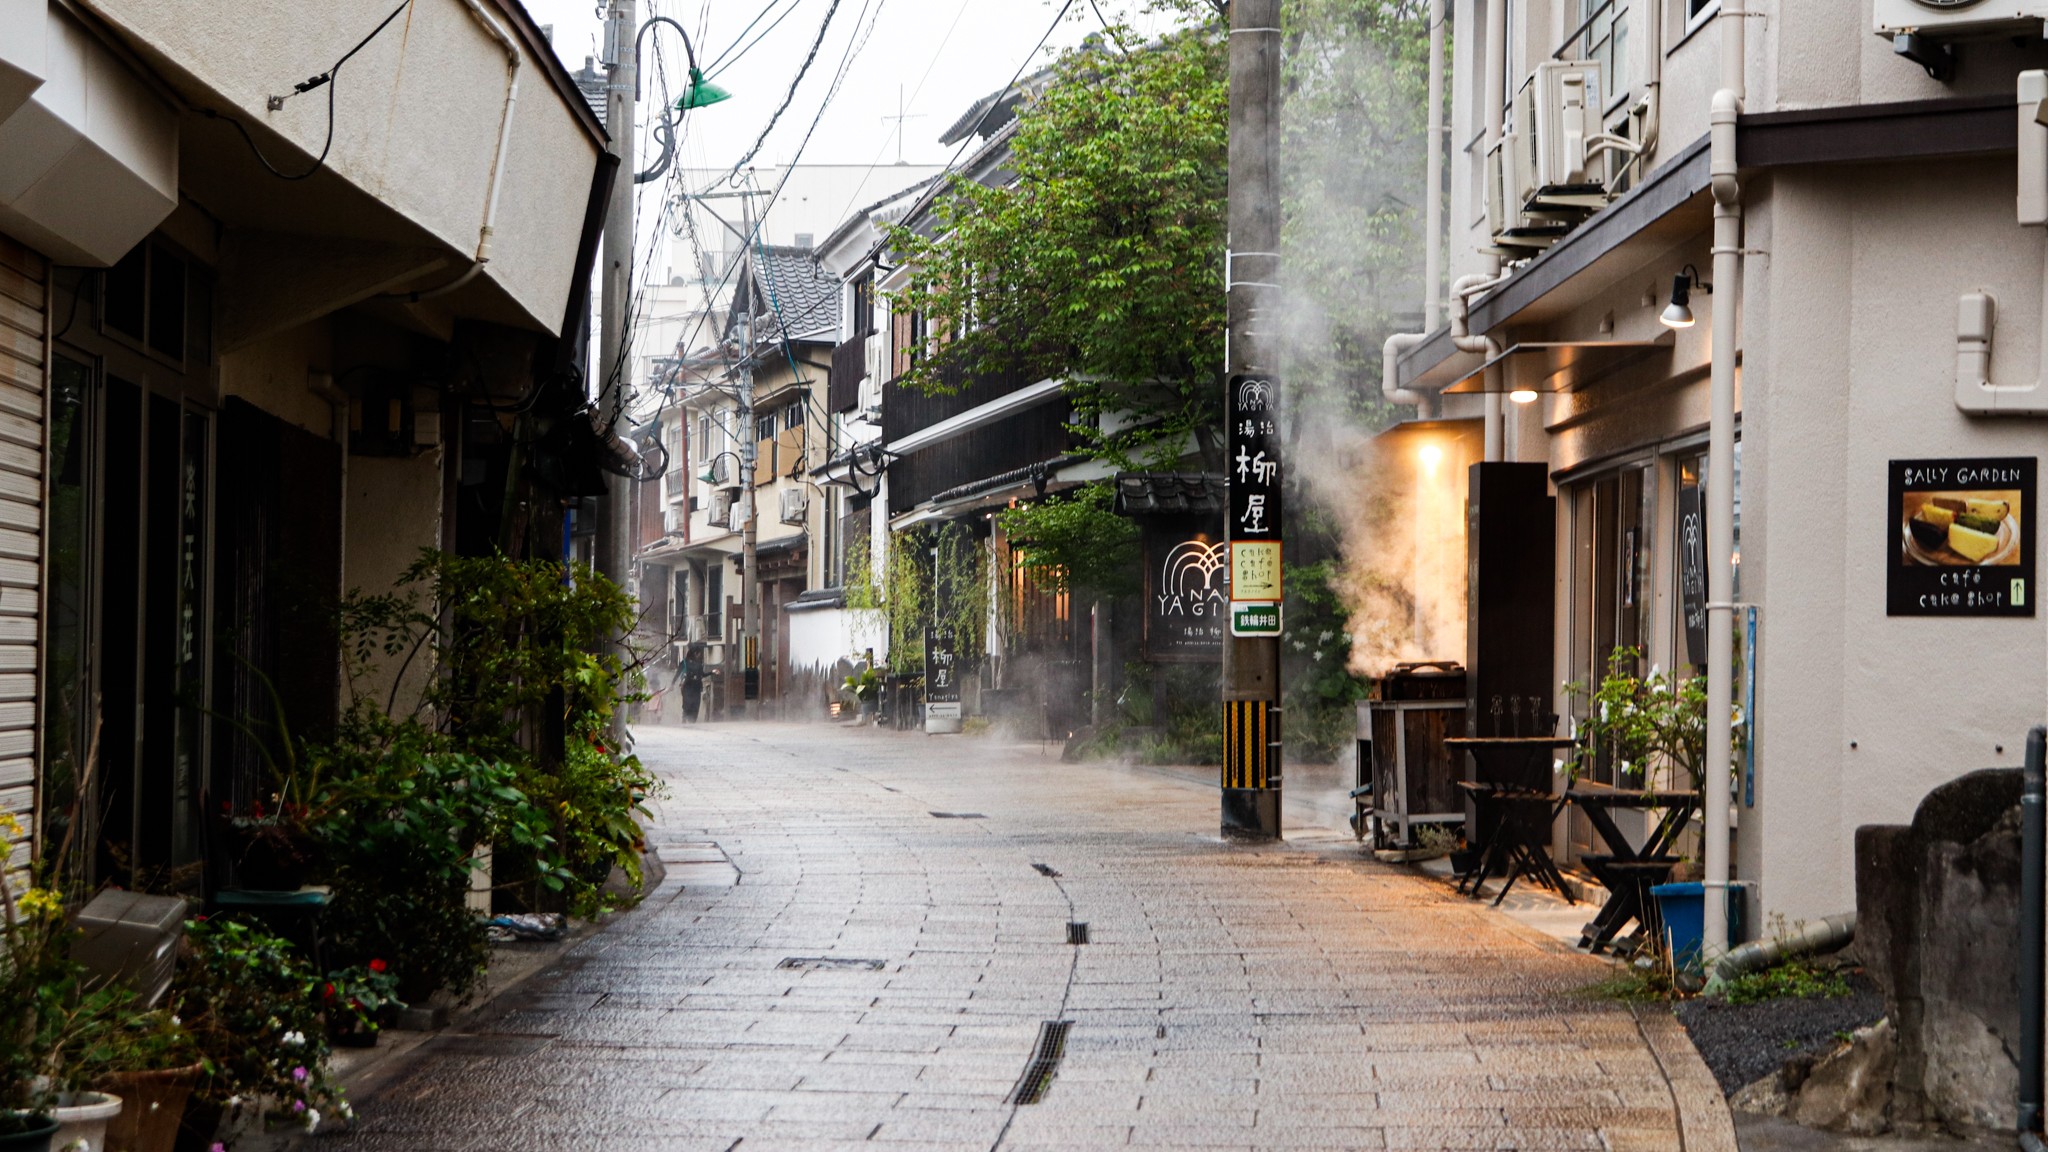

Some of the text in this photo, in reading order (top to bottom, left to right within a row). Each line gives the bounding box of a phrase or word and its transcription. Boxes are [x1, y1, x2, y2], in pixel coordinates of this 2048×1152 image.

[1238, 419, 1274, 437] 湯治
[1904, 467, 2021, 486] SALLY GARDEN
[1236, 445, 1277, 533] 柳屋
[1940, 569, 1981, 588] café
[1919, 592, 1960, 608] cake
[932, 646, 952, 687] 柳屋
